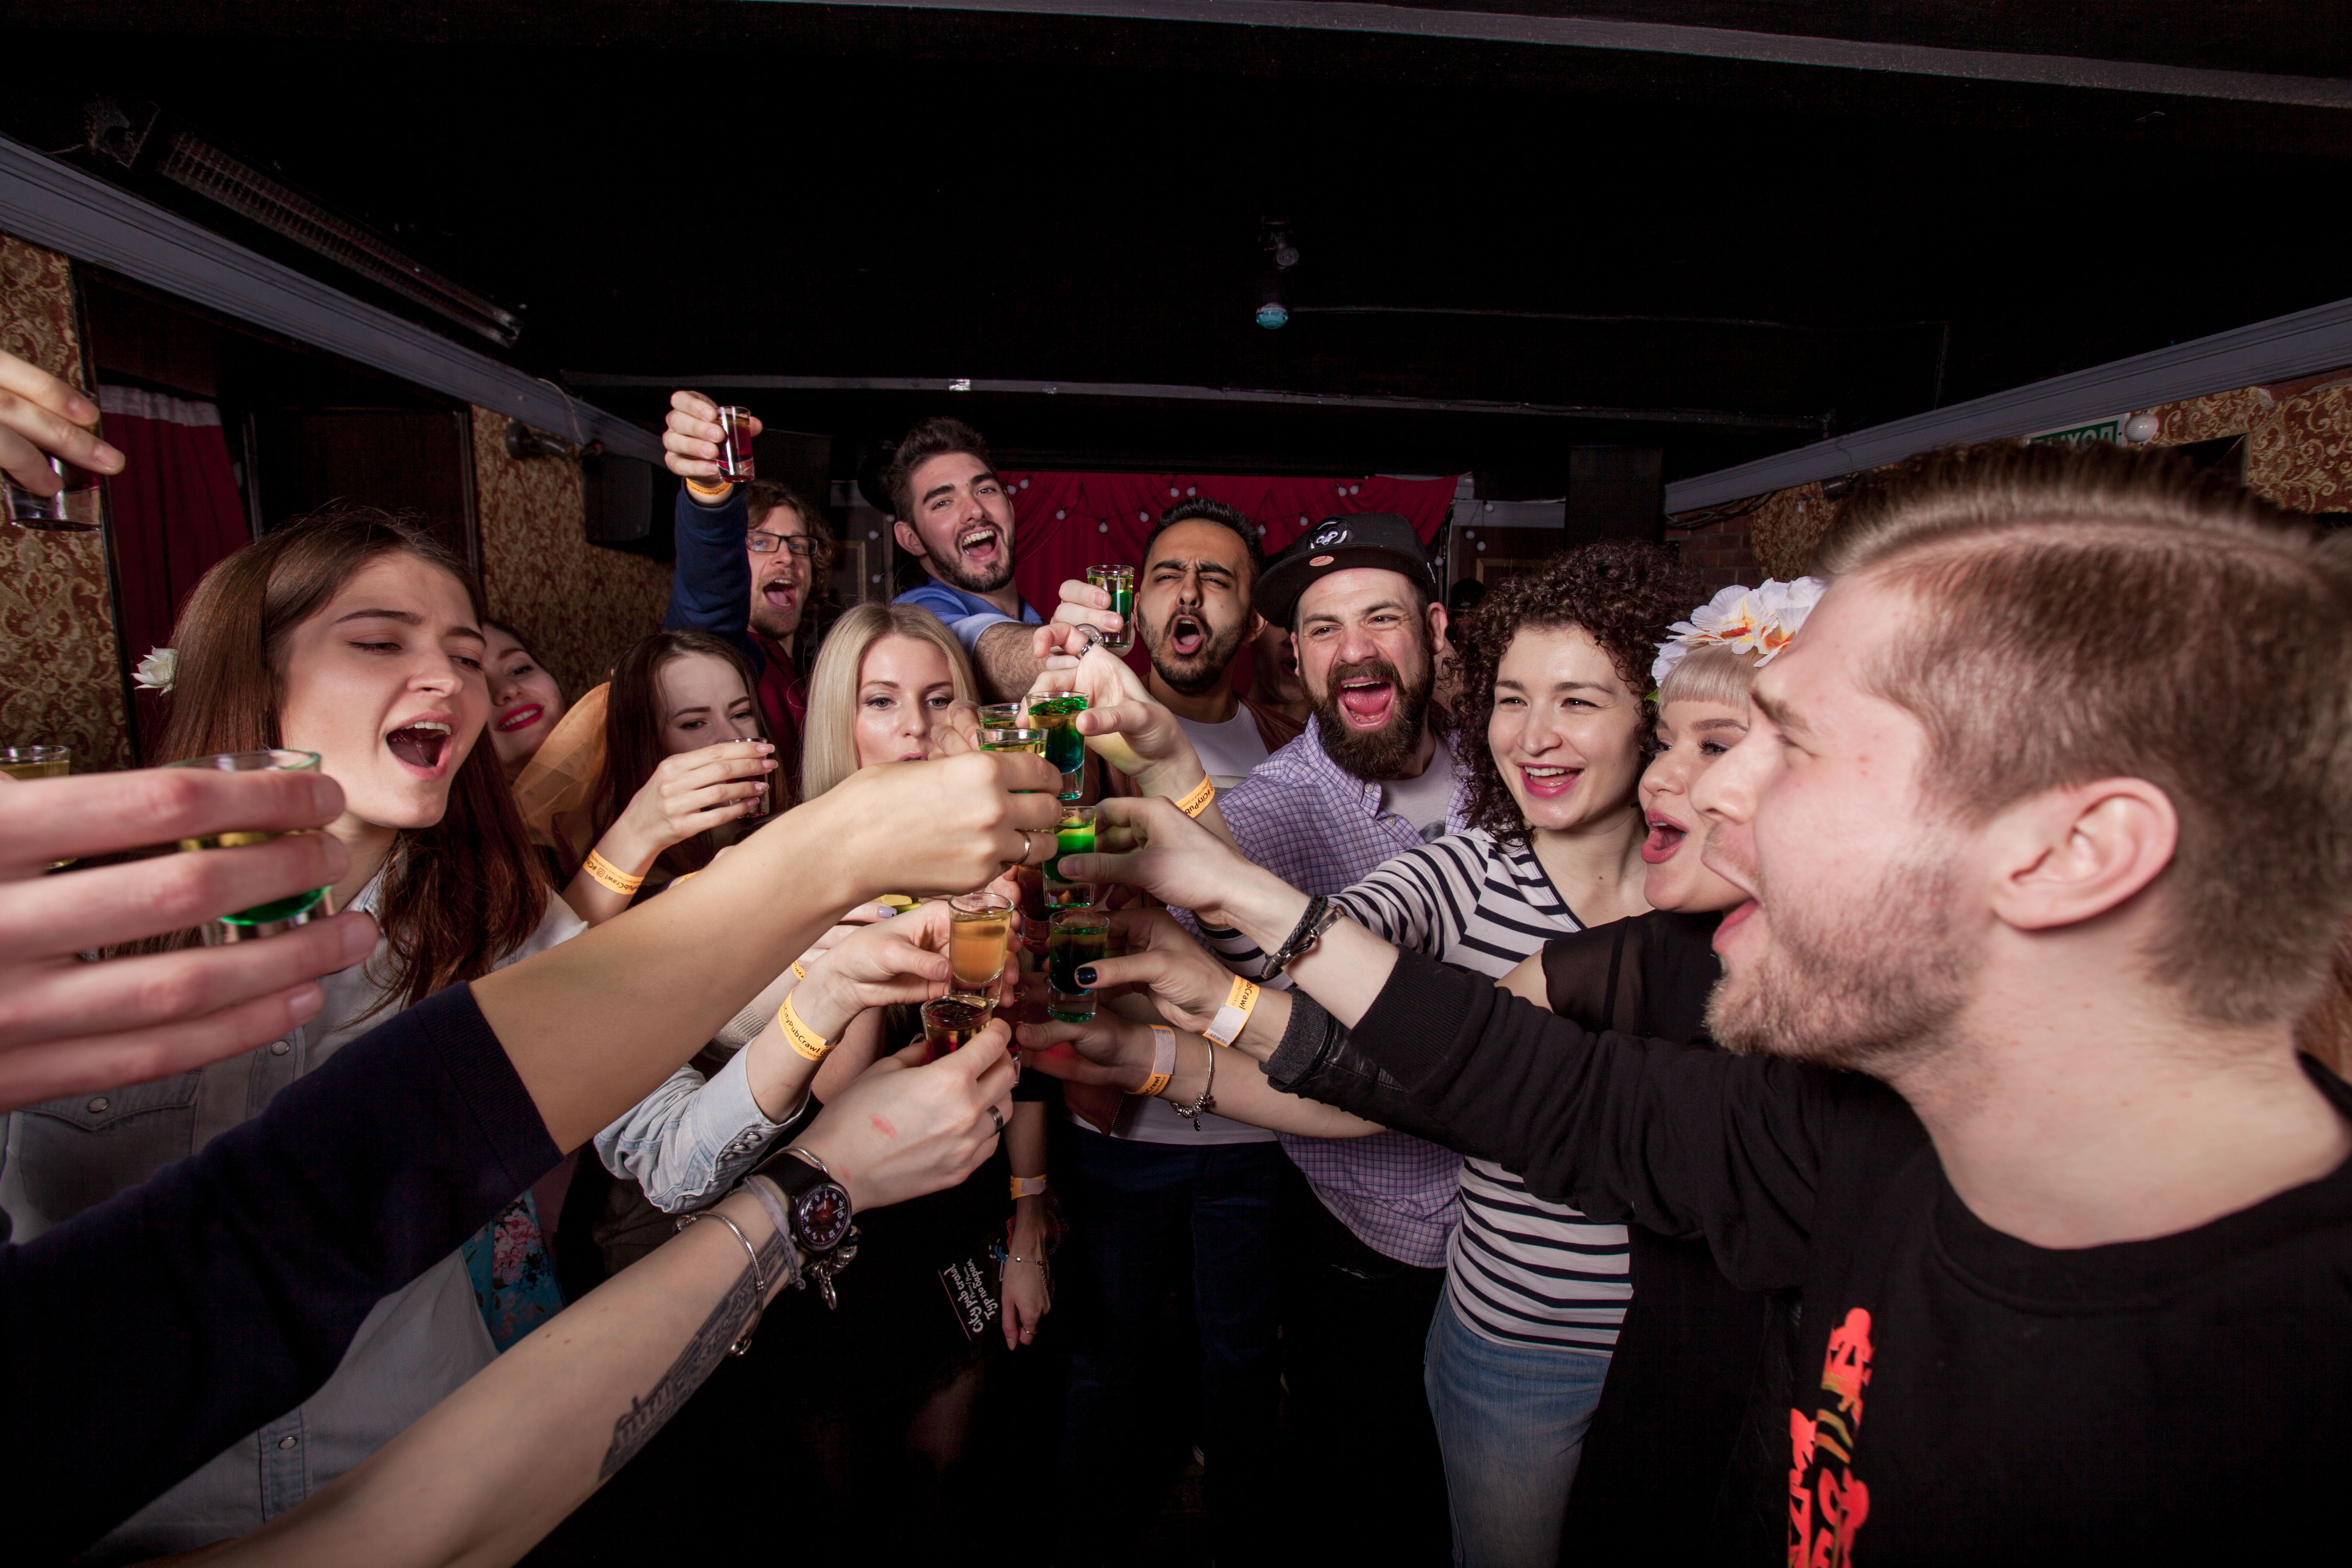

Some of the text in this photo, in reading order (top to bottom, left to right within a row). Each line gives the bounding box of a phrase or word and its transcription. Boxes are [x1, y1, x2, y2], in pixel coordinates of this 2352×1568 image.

[2034, 426, 2115, 451] ХОД
[837, 1210, 844, 1219] 10
[829, 1229, 835, 1238] 12
[944, 1263, 983, 1333] City pub crawl
